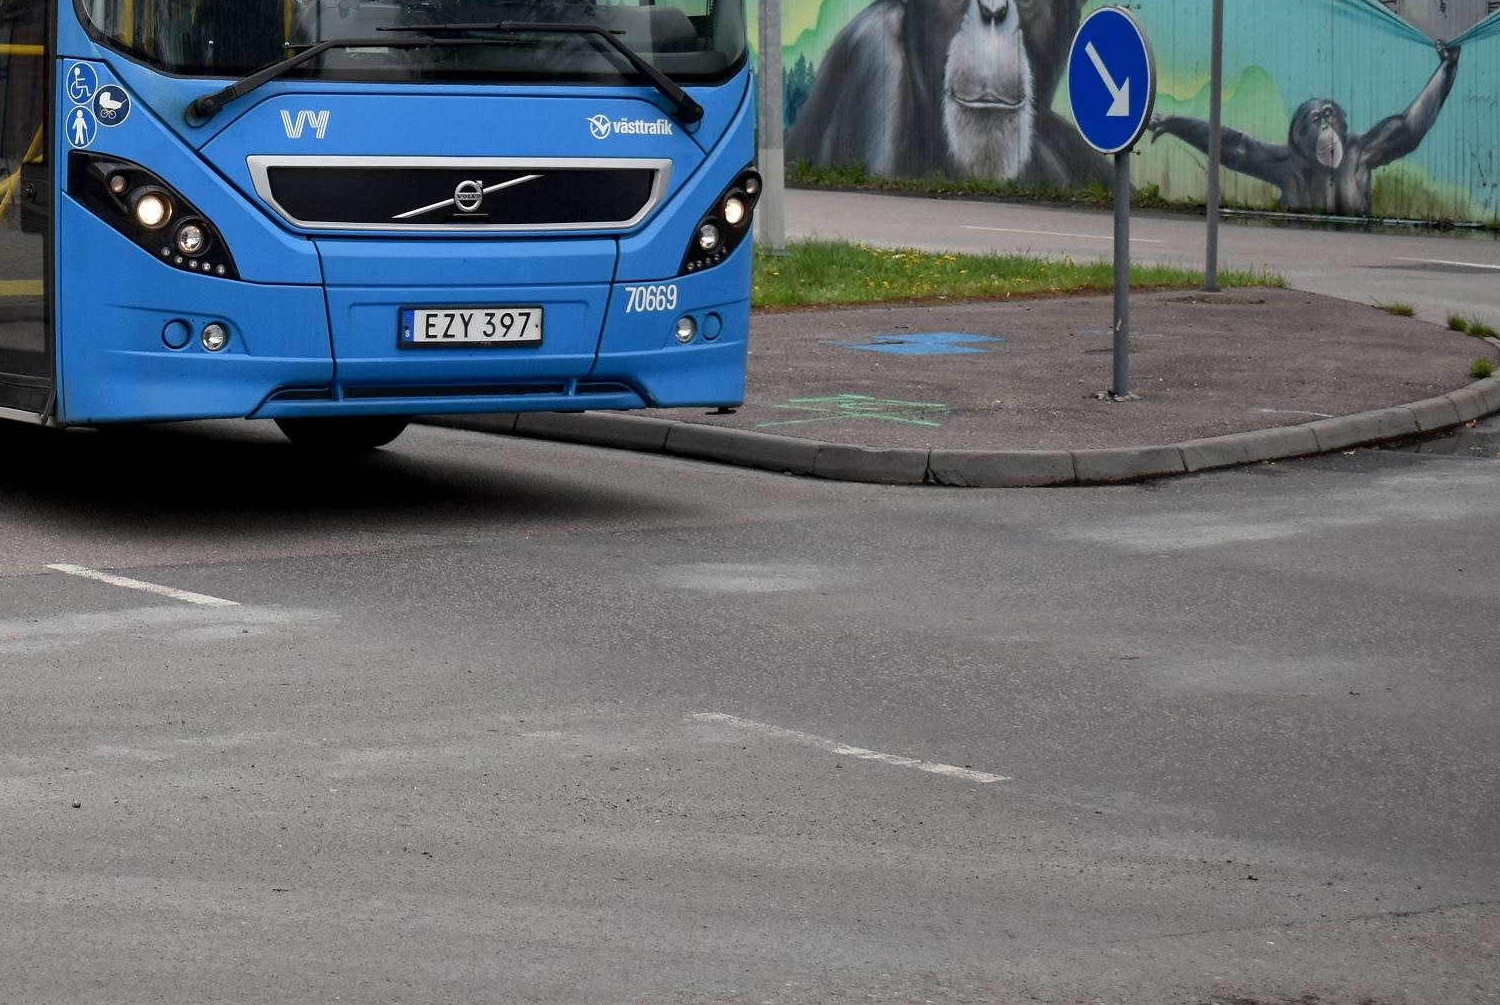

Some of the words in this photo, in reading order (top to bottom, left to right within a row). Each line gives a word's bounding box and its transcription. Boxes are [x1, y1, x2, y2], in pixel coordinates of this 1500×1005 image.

[613, 116, 673, 136] västtrafik
[625, 285, 678, 313] 70669
[424, 313, 474, 339] EZY
[482, 312, 532, 338] 397
